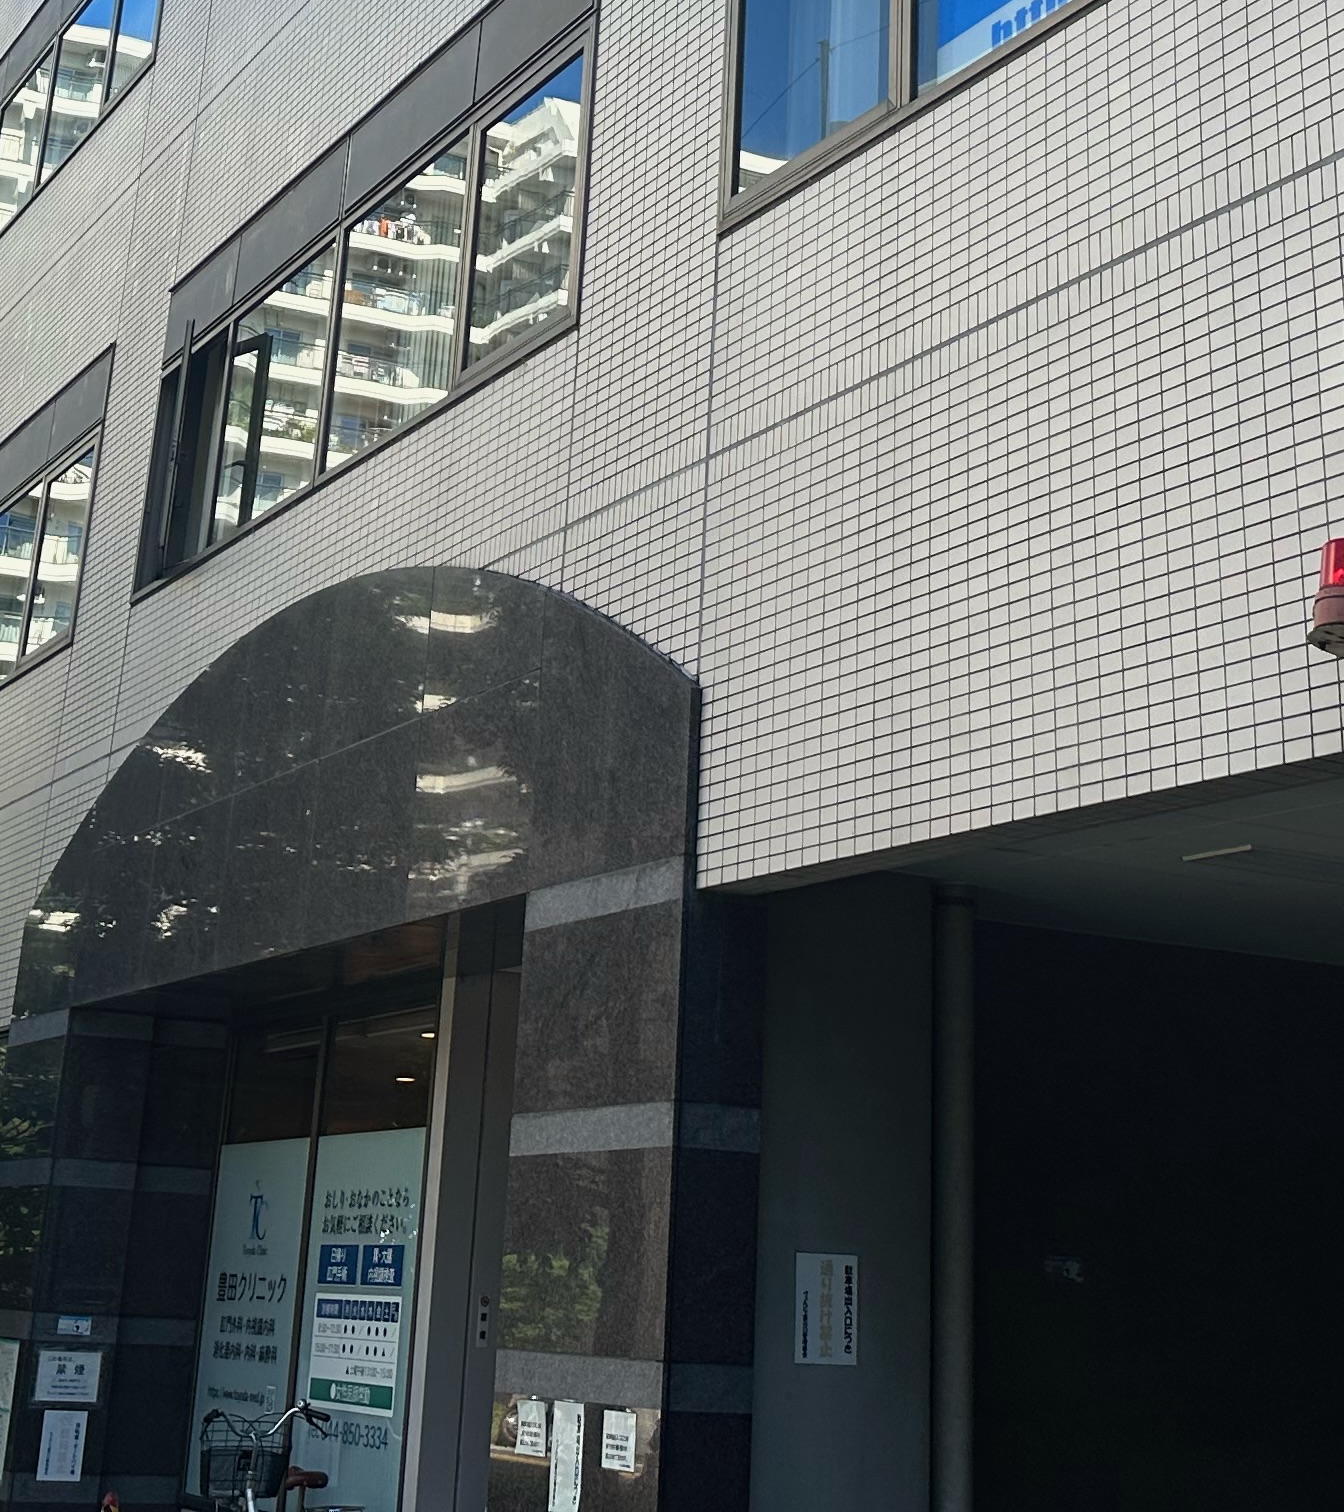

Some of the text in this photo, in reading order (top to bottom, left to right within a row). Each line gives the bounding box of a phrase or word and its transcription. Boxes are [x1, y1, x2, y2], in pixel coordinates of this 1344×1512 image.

[217, 1272, 287, 1303] 豊田クリニック
